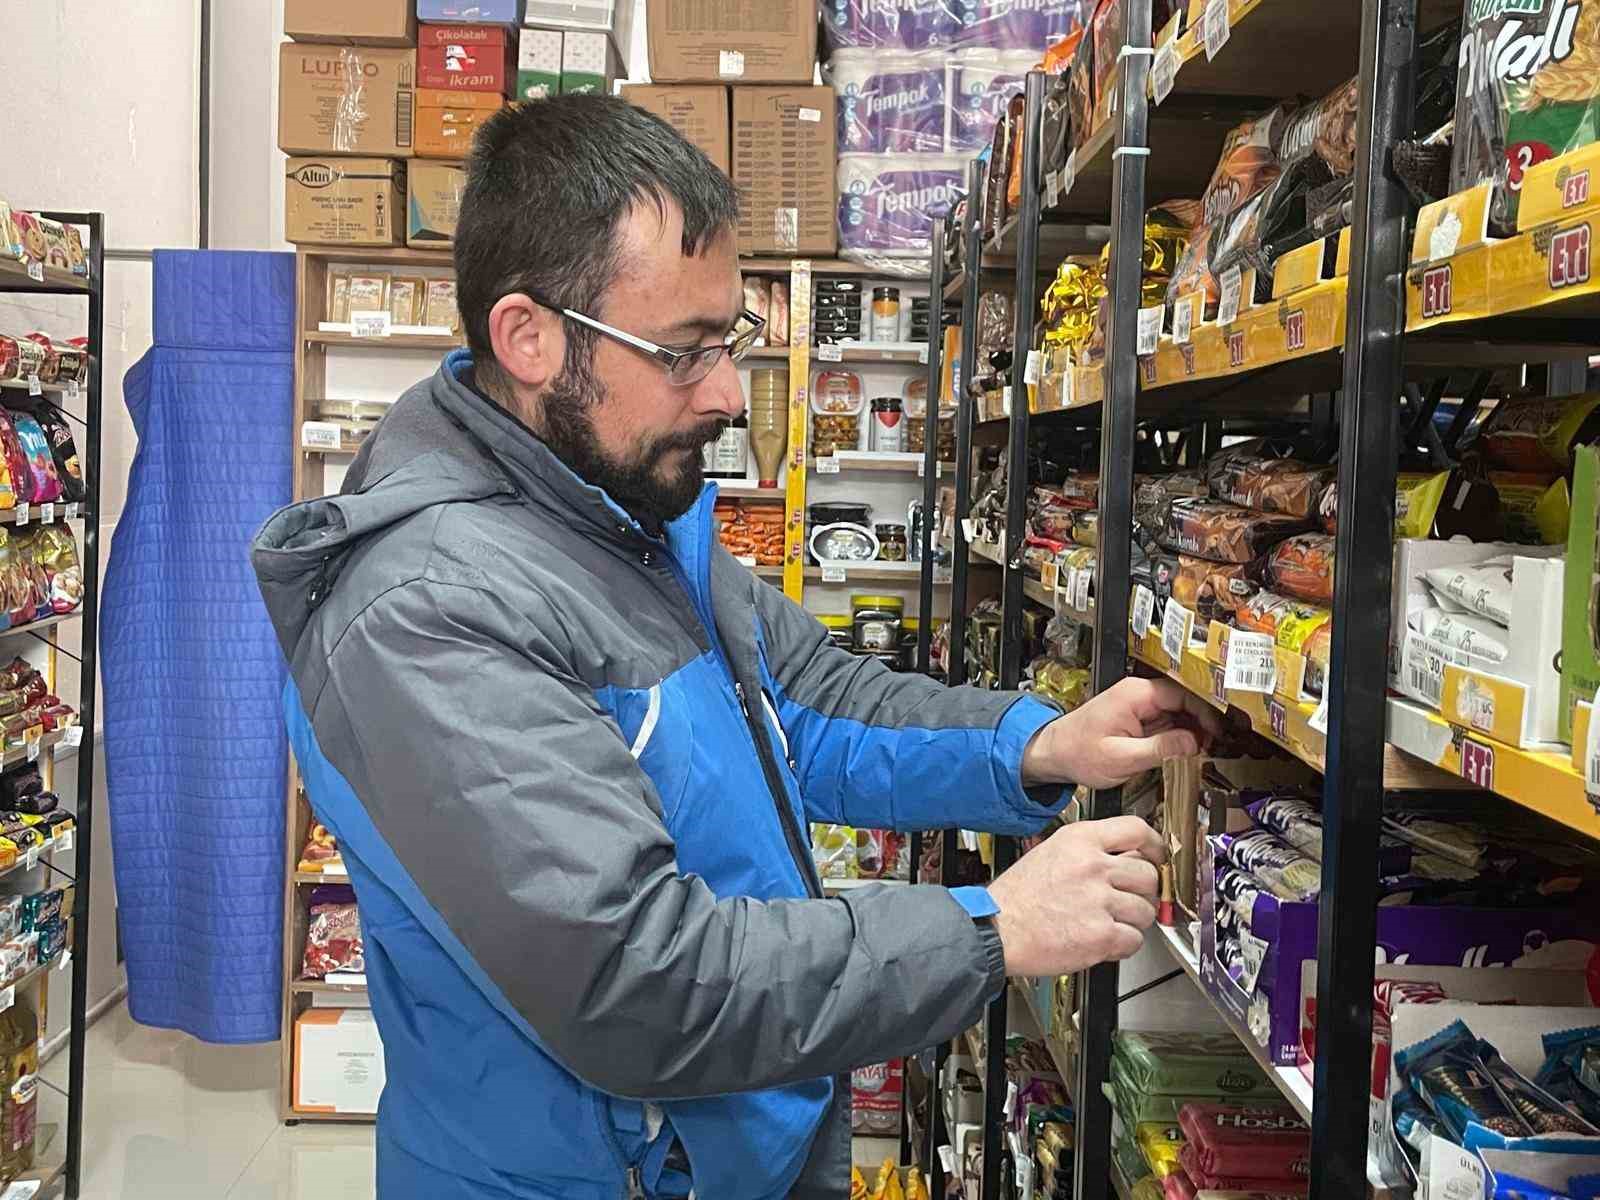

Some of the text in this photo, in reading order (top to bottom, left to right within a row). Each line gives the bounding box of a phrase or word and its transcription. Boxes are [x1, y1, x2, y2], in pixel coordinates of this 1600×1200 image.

[928, 32, 938, 45] 6
[301, 58, 379, 77] LUPO
[861, 82, 930, 118] Tempok
[868, 179, 957, 220] Tempok
